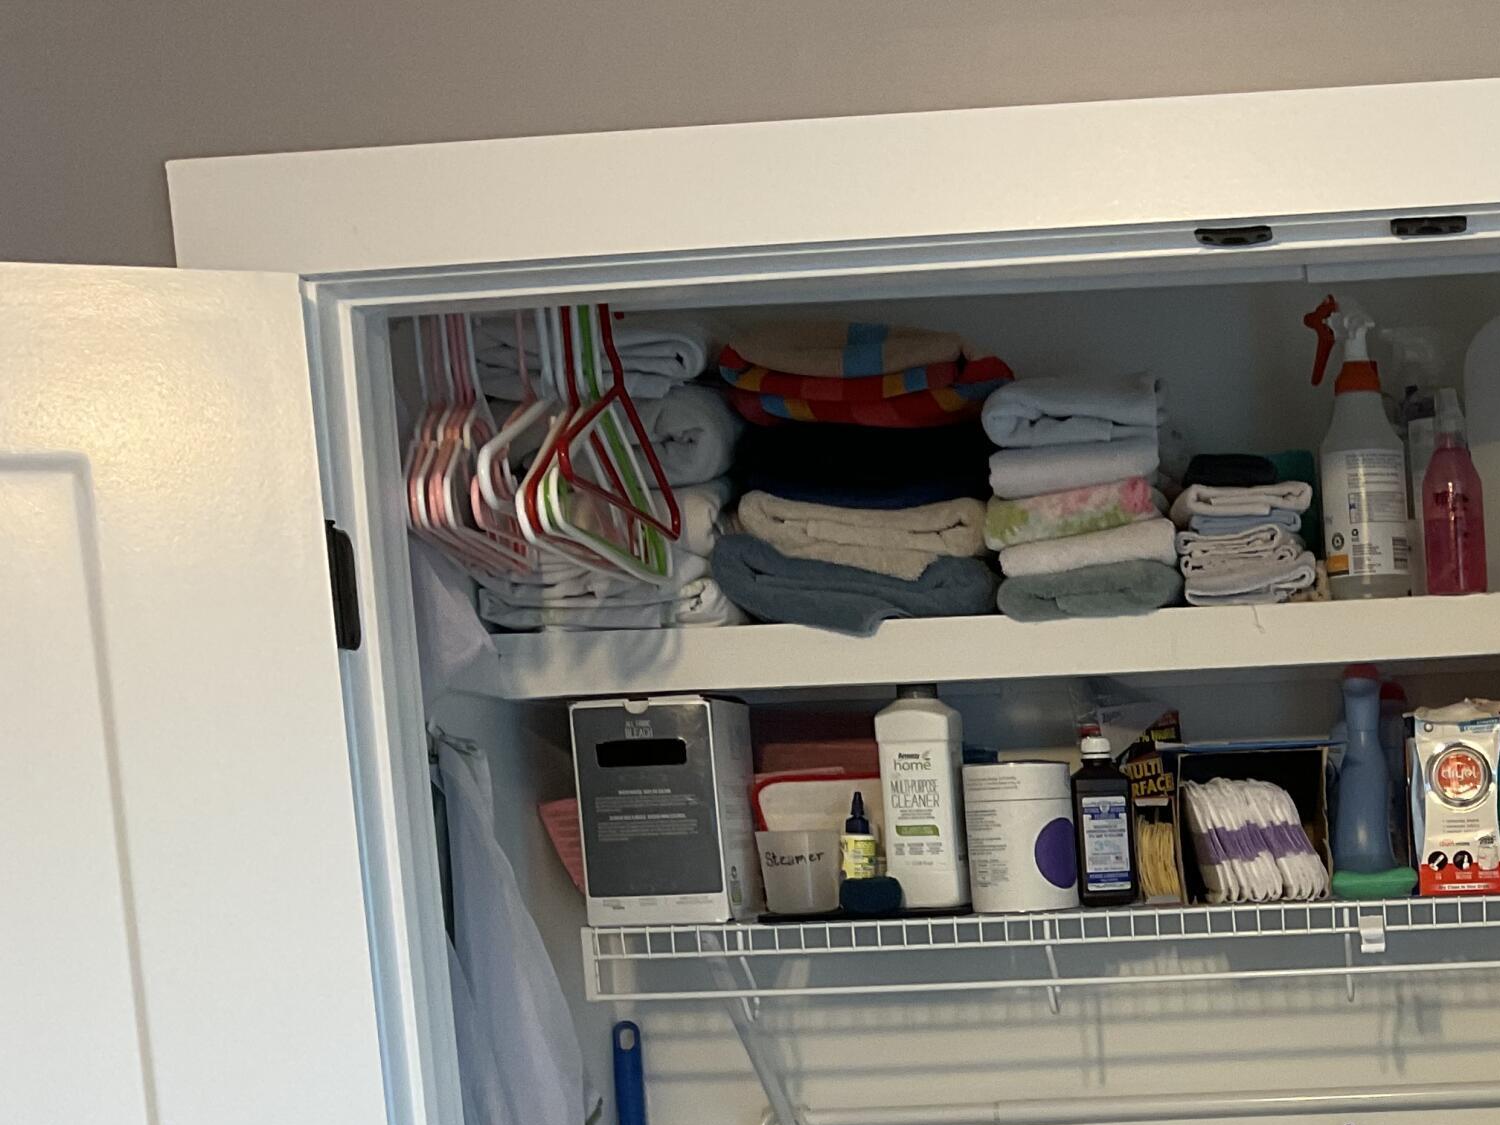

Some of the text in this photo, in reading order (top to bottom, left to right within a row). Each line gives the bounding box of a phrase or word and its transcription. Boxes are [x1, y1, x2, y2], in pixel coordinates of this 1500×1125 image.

[894, 759, 931, 770] home
[891, 793, 940, 808] CLEANER
[765, 851, 824, 867] Steamer
